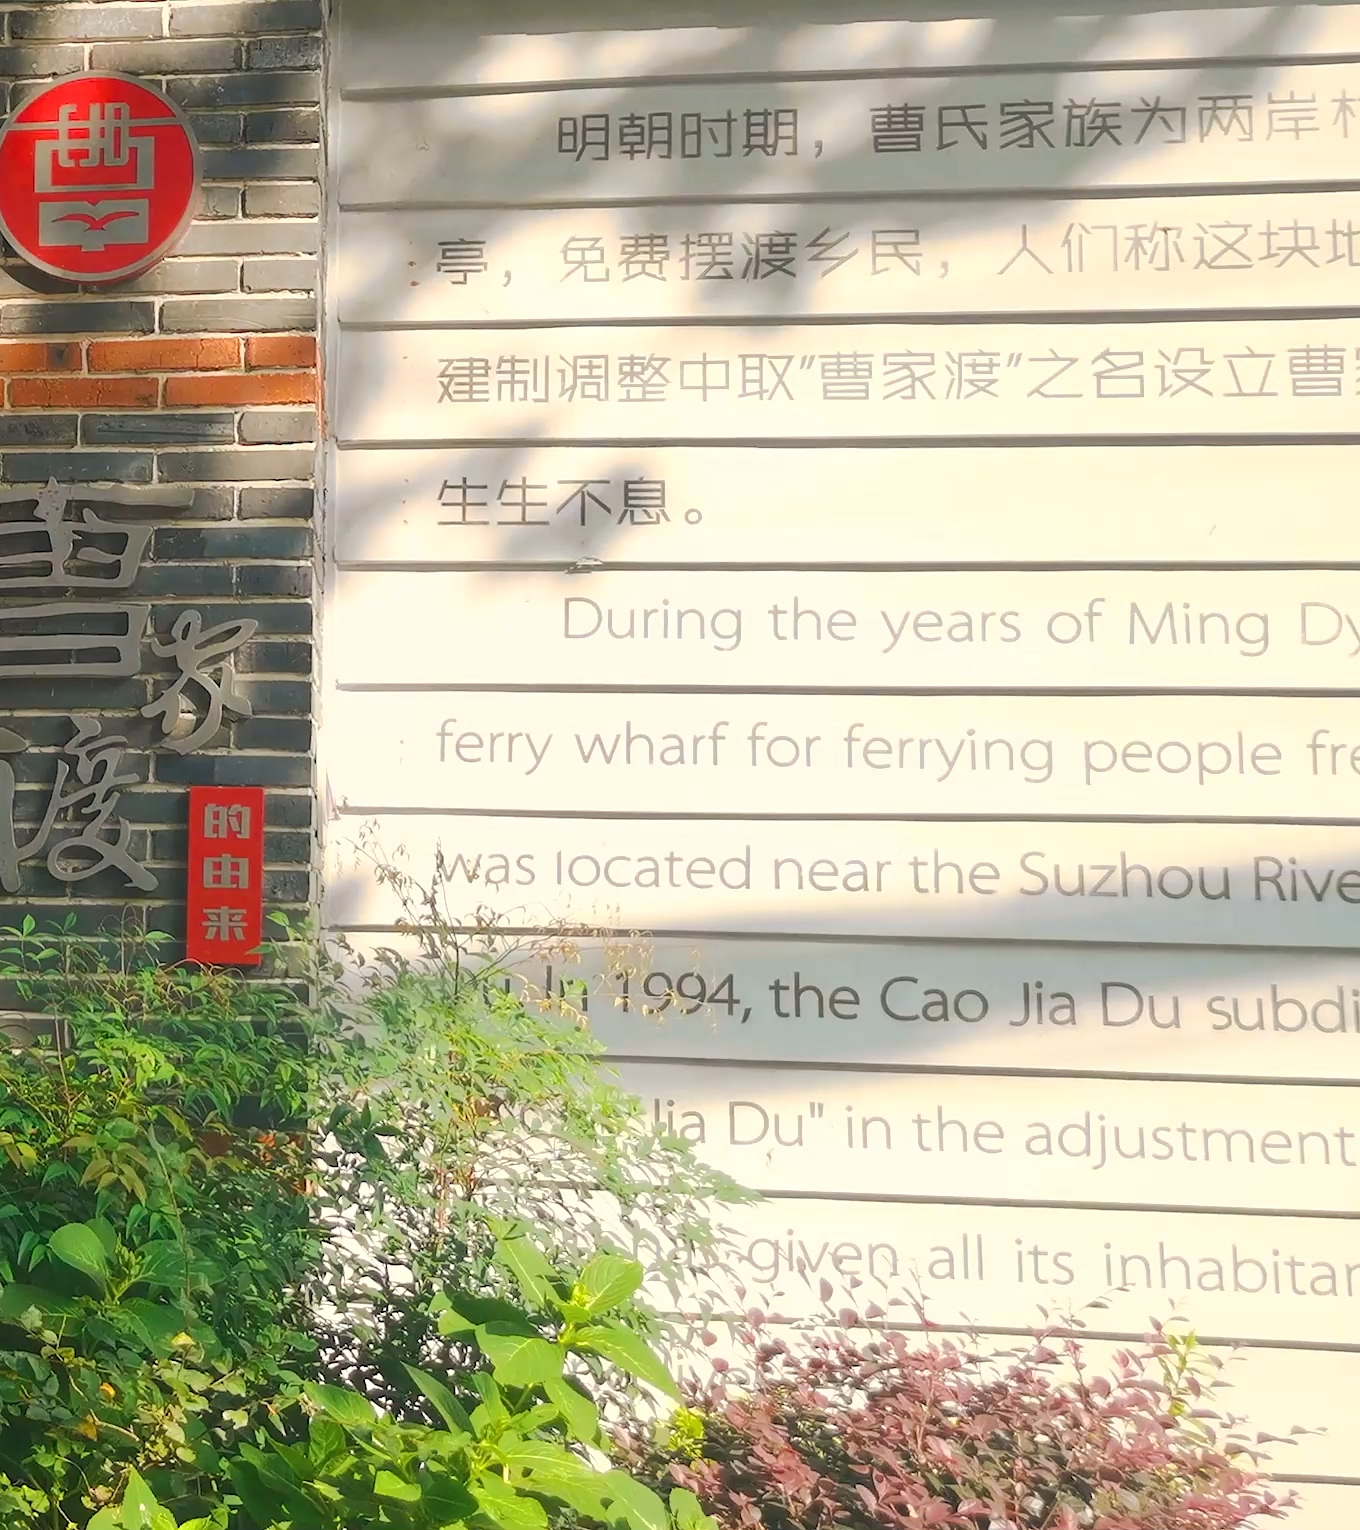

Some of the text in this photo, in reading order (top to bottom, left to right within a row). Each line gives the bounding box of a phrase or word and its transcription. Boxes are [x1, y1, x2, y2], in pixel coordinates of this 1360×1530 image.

[437, 476, 703, 527] 生生不息。
[564, 597, 742, 651] During
[767, 596, 857, 641] the
[880, 610, 1021, 654] years
[1047, 597, 1106, 644] of
[1129, 602, 1269, 657] Ming
[436, 718, 553, 776] ferry
[574, 720, 729, 766] wharf
[747, 721, 821, 767] for
[843, 723, 1053, 783] ferrying
[1084, 731, 1282, 786] people
[202, 803, 250, 941] 的由来
[439, 851, 537, 886] was
[774, 858, 892, 892] near
[908, 848, 1000, 895] the
[1019, 851, 1231, 901] Suzhou
[616, 970, 752, 1024] 1994,
[768, 971, 860, 1020] the
[880, 976, 989, 1023] Cao
[1009, 980, 1077, 1027] Jia
[1100, 981, 1181, 1029] Du
[729, 1101, 824, 1147] Du"
[845, 1105, 891, 1150] in
[912, 1105, 1004, 1154] the
[1025, 1111, 1357, 1170] adjustment
[748, 1229, 899, 1284] given
[928, 1233, 983, 1281] all
[1015, 1238, 1074, 1285] its
